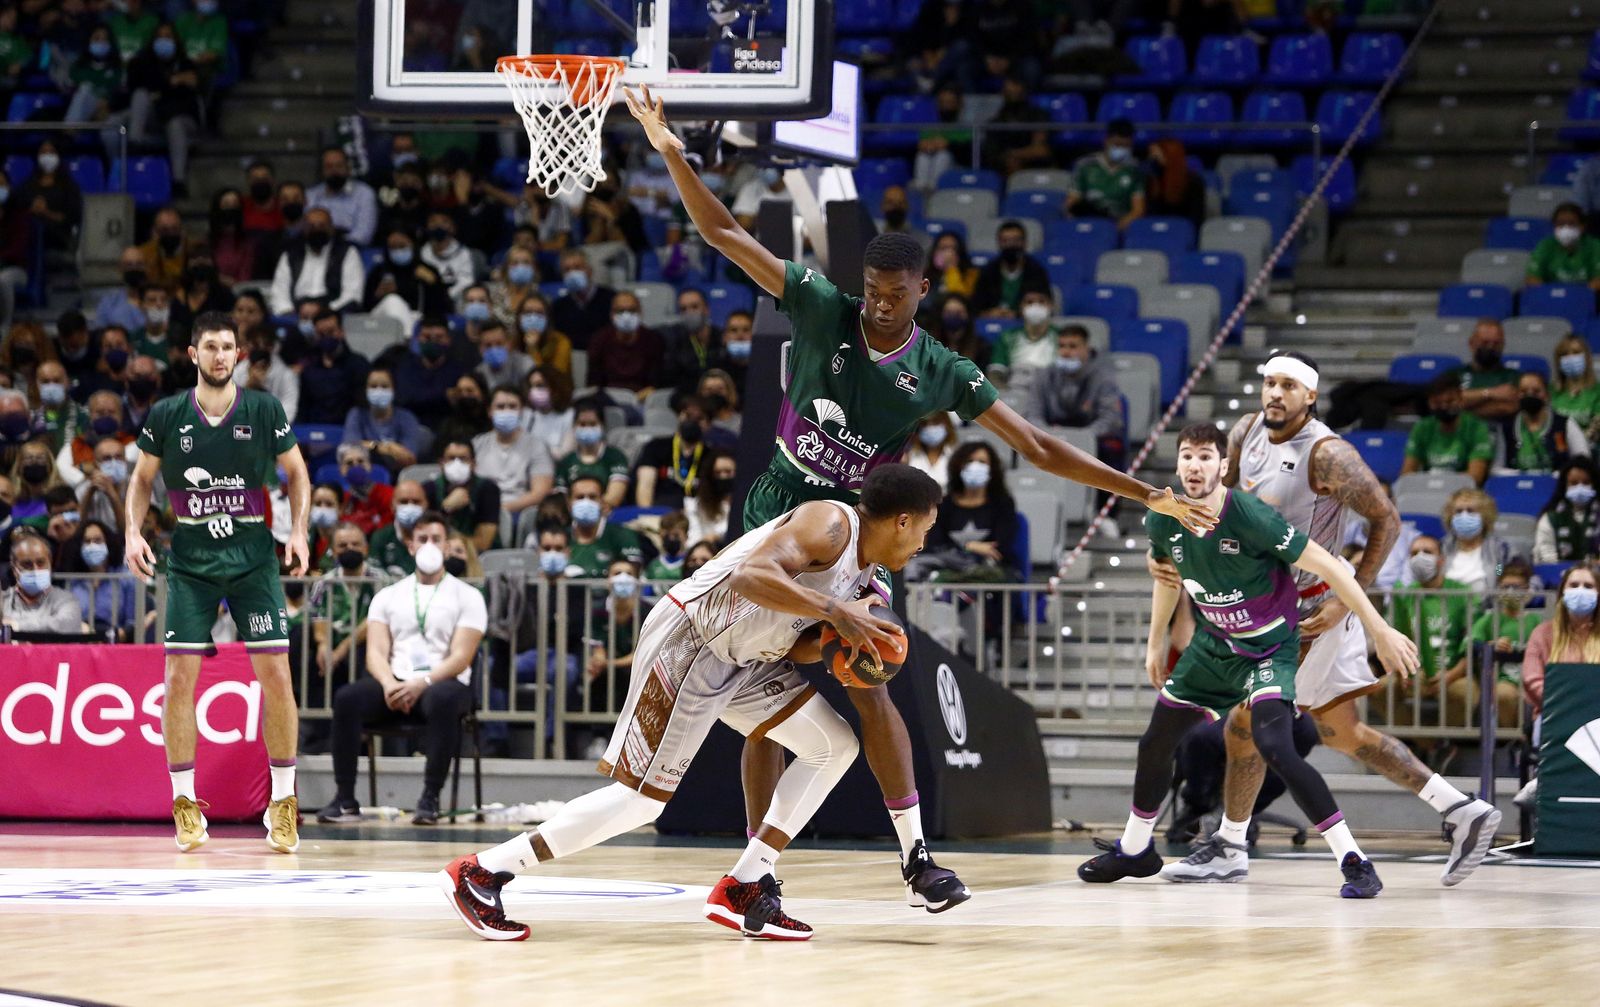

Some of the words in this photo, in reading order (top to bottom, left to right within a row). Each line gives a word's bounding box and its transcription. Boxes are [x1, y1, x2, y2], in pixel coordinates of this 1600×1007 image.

[734, 47, 757, 60] liga
[734, 59, 781, 70] endesa
[837, 427, 878, 458] Unicaj
[823, 447, 866, 476] MÁLAA
[1204, 588, 1244, 603] Unicaja
[763, 696, 783, 712] GRUPO
